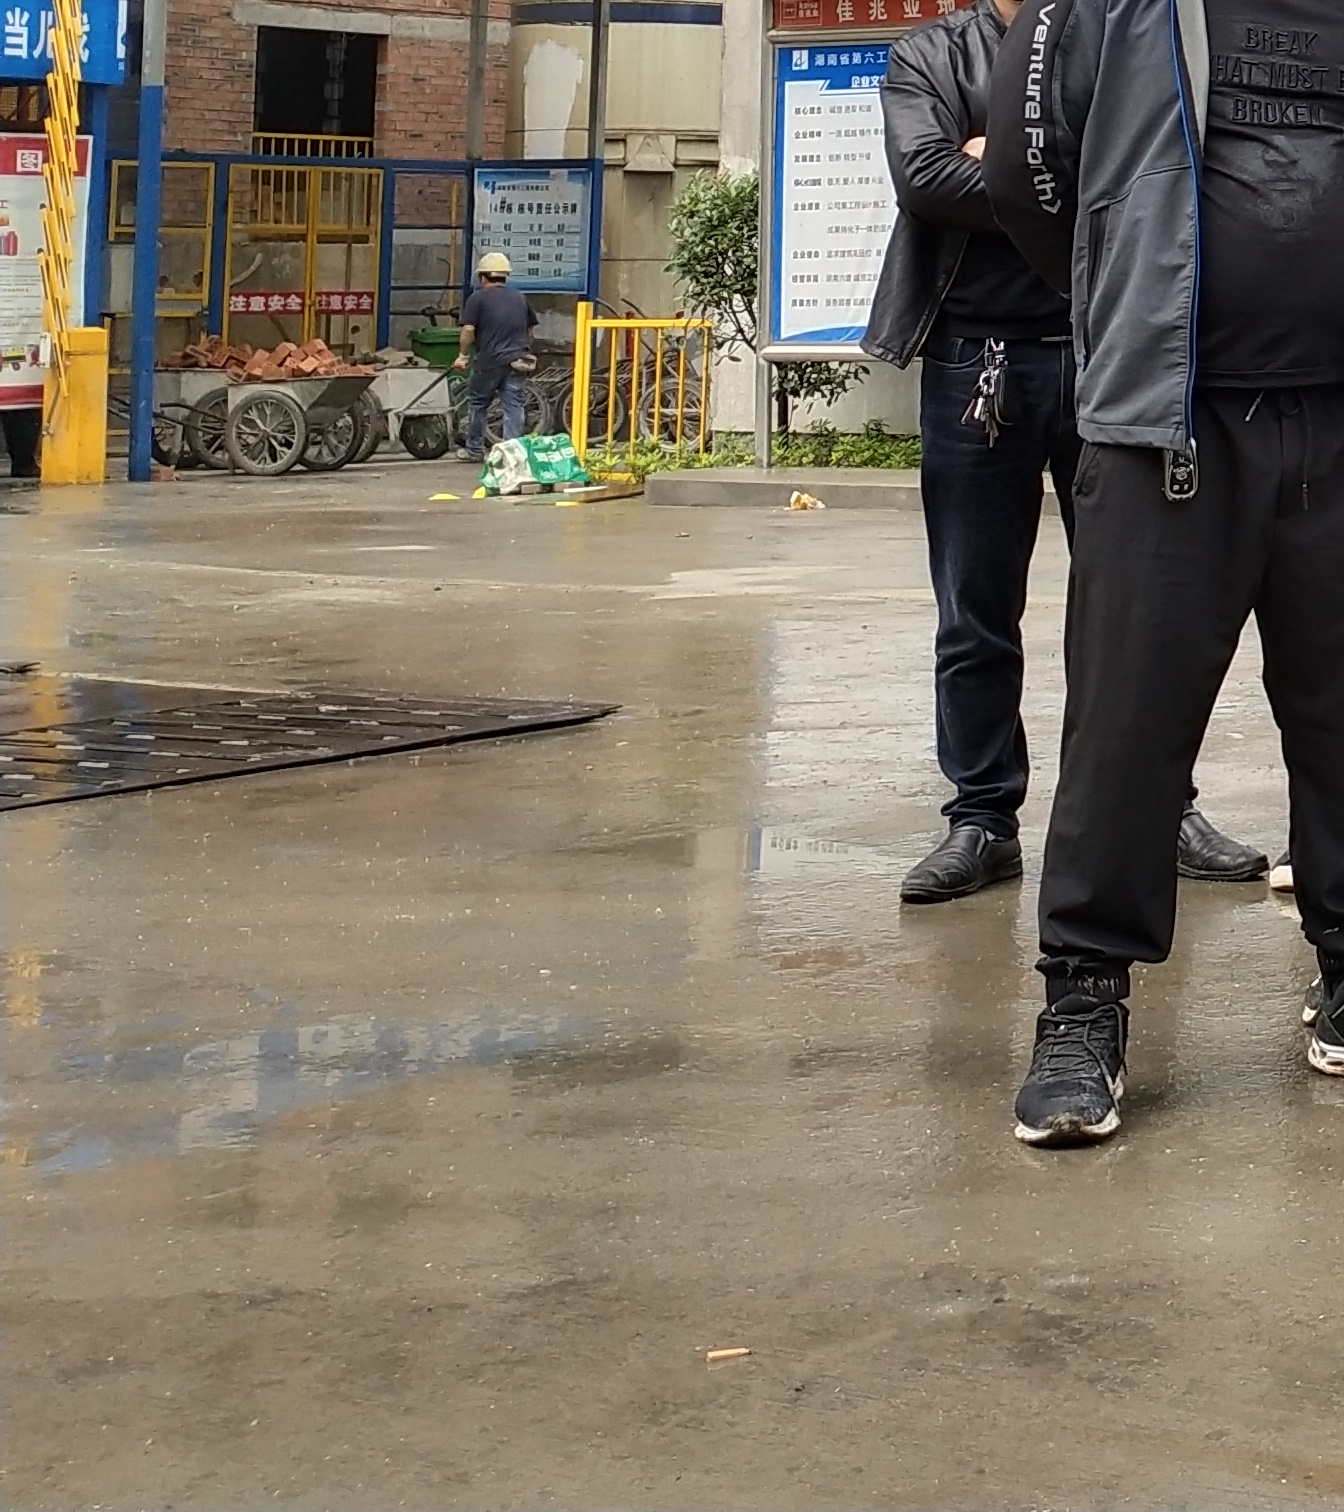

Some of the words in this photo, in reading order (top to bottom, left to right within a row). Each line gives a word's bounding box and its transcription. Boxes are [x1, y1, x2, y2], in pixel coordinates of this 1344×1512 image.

[1245, 26, 1318, 55] BREAK
[813, 51, 887, 67] 湖南省第六工
[1024, 2, 1057, 120] Venture
[1211, 54, 1260, 85] HAT
[1268, 59, 1330, 90] MUST
[1232, 96, 1323, 125] BROKEN
[1024, 127, 1057, 201] Forth
[229, 294, 303, 312] 注意安全
[315, 294, 372, 310] 注意安全
